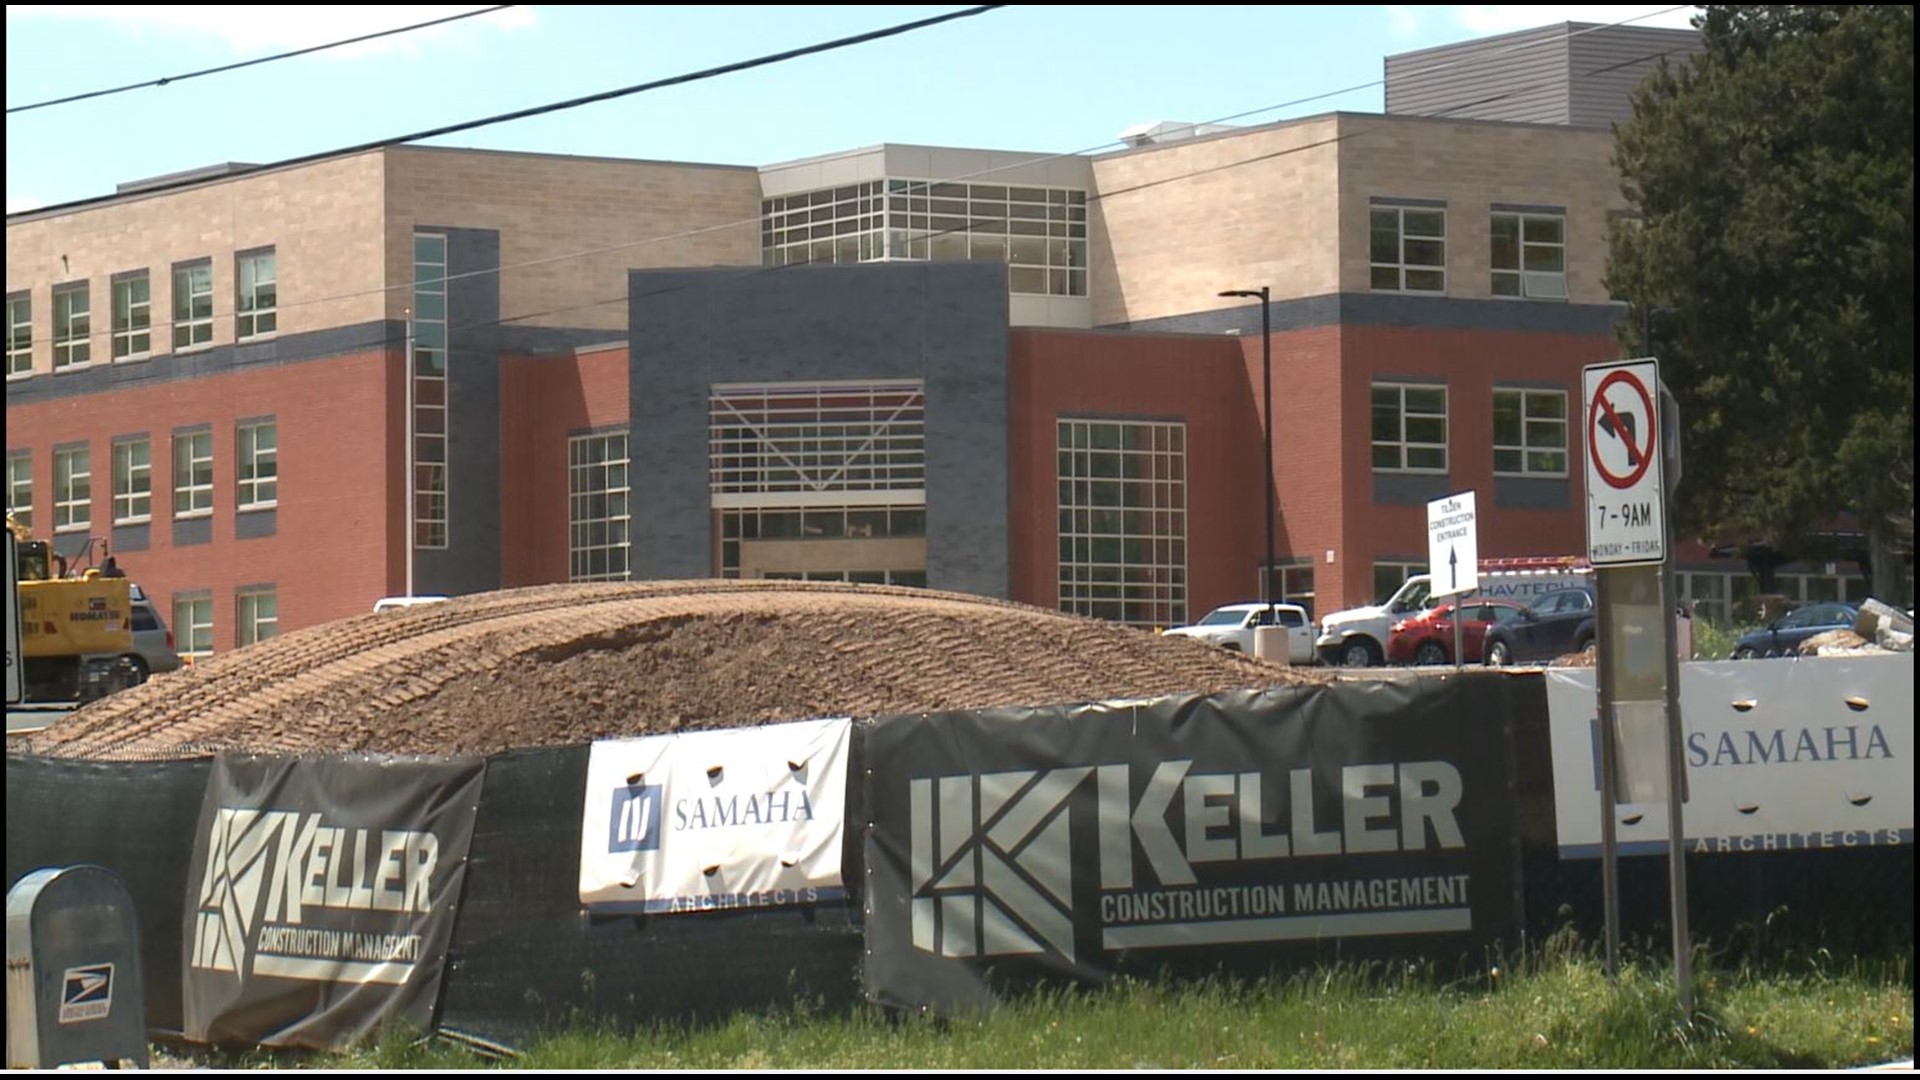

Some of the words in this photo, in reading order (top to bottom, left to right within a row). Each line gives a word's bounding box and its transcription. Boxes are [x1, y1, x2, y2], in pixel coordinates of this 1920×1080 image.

[1429, 511, 1474, 531] CONSTRUCTION
[1436, 527, 1468, 543] ENTRANCE
[1686, 723, 1896, 768] SAMAHA
[674, 788, 816, 832] SAMAHA
[1097, 759, 1467, 889] KELLER
[1694, 828, 1902, 854] ARCHITECTS
[263, 811, 439, 925] KELLER
[669, 886, 818, 913] ARCHITECTS
[1101, 886, 1284, 923] CONSTRUCTION
[1293, 874, 1470, 911] MANAGEMENT
[257, 926, 339, 957] CONSTRUCTION
[342, 931, 422, 961] MANAGENT
